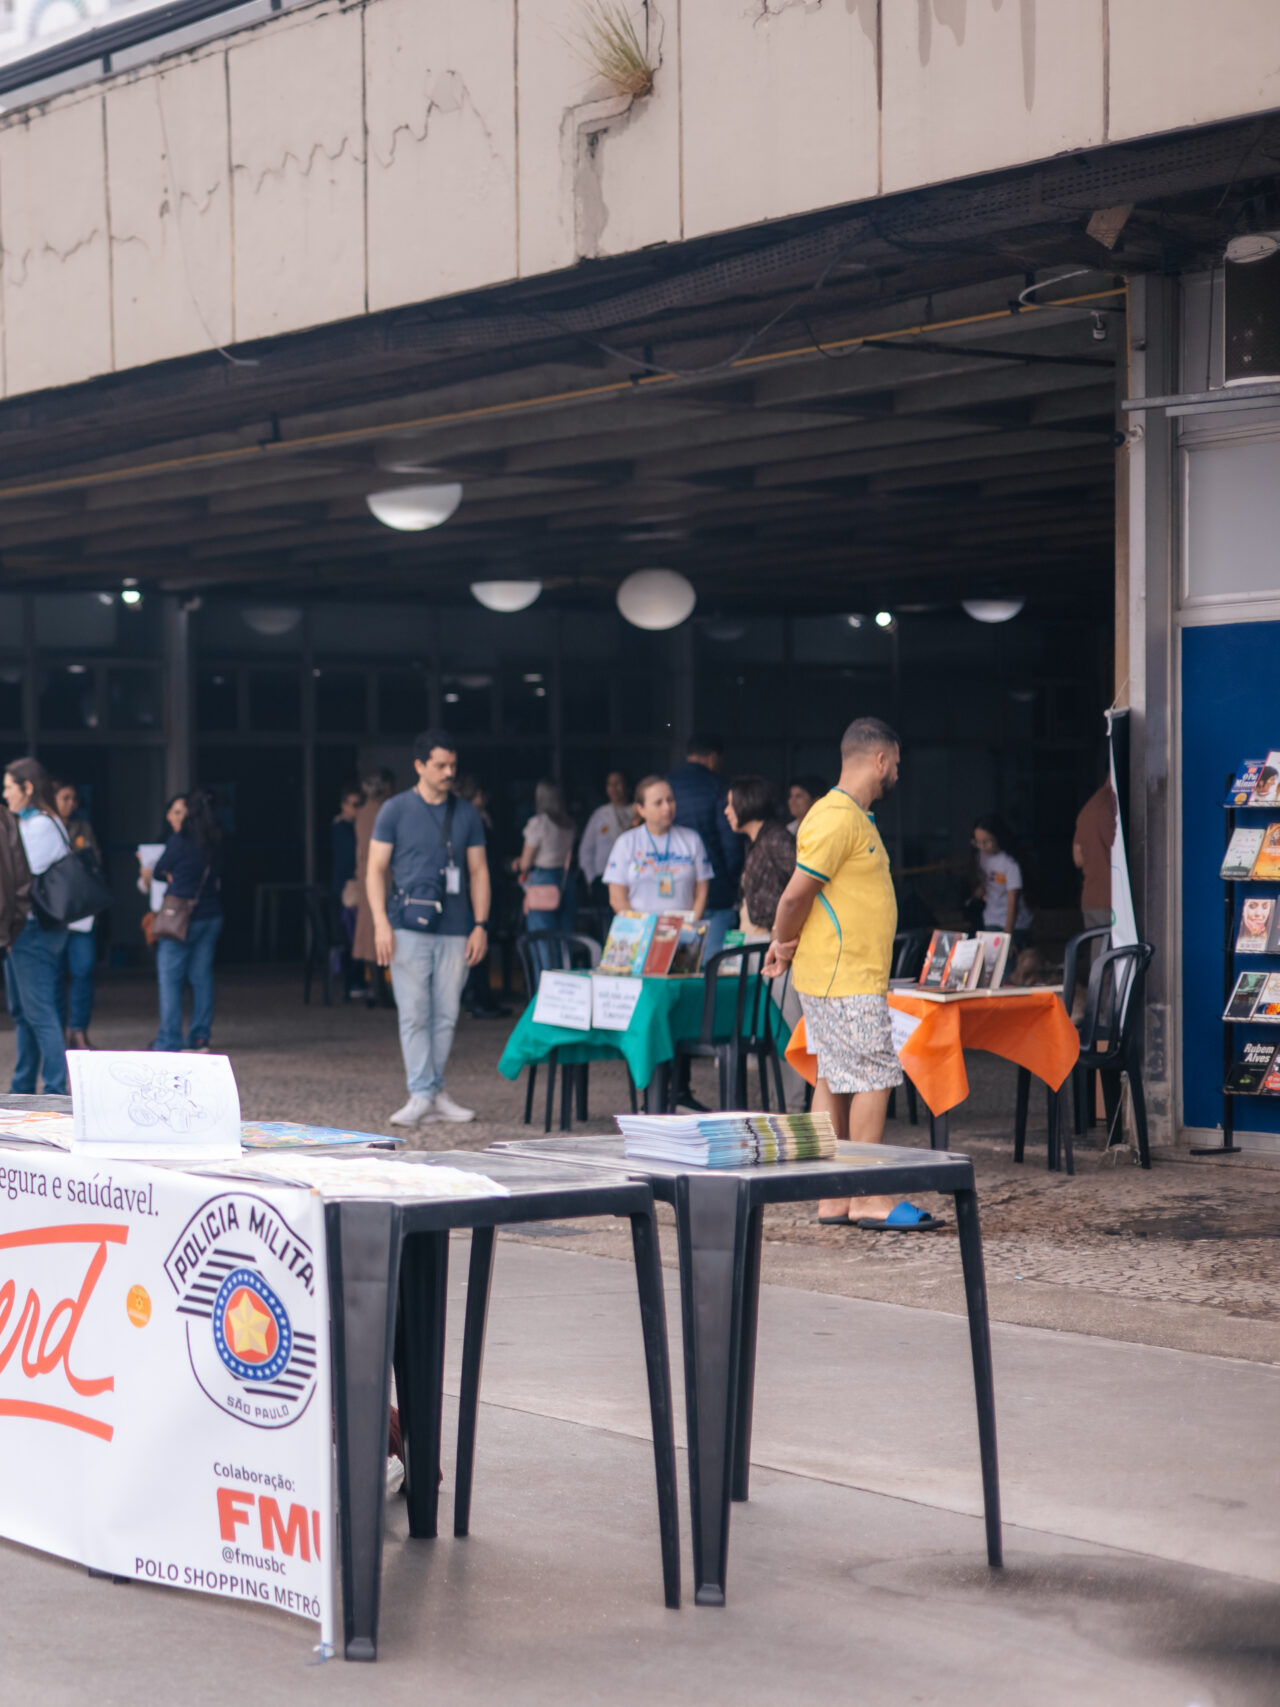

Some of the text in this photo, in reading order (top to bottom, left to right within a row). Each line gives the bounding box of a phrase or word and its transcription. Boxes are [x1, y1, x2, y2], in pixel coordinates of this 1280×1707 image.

[1245, 1053, 1271, 1063] Alves
[52, 1176, 62, 1199] e
[67, 1172, 159, 1217] saúdavel.
[174, 1202, 315, 1297] POLICIA MILITA
[227, 1395, 289, 1420] SÃO PAULO
[213, 1462, 296, 1492] Colaboração:
[222, 1546, 287, 1575] @fmusbc
[135, 1557, 321, 1618] POLO SHOPPING METRÓ
